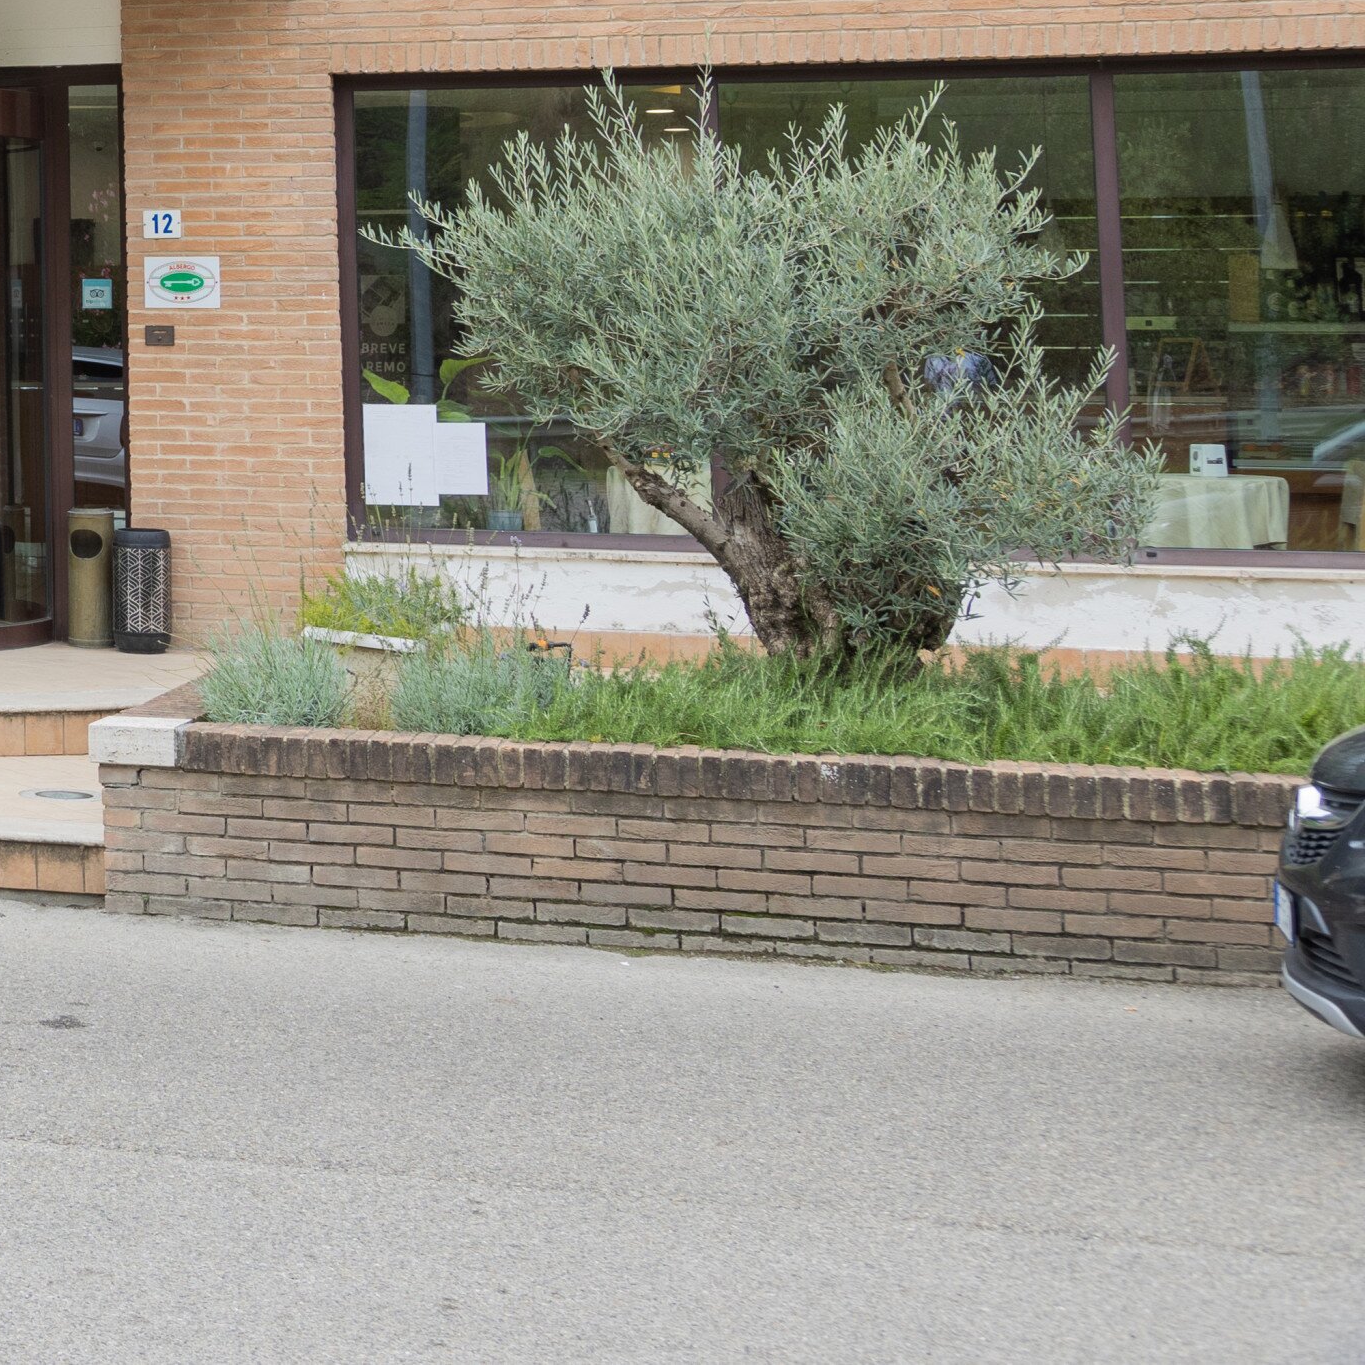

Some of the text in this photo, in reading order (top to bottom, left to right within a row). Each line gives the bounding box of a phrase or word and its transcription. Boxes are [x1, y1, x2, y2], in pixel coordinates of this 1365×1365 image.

[151, 213, 173, 234] 12
[169, 263, 196, 271] ALBERGO
[361, 342, 406, 354] BREVE
